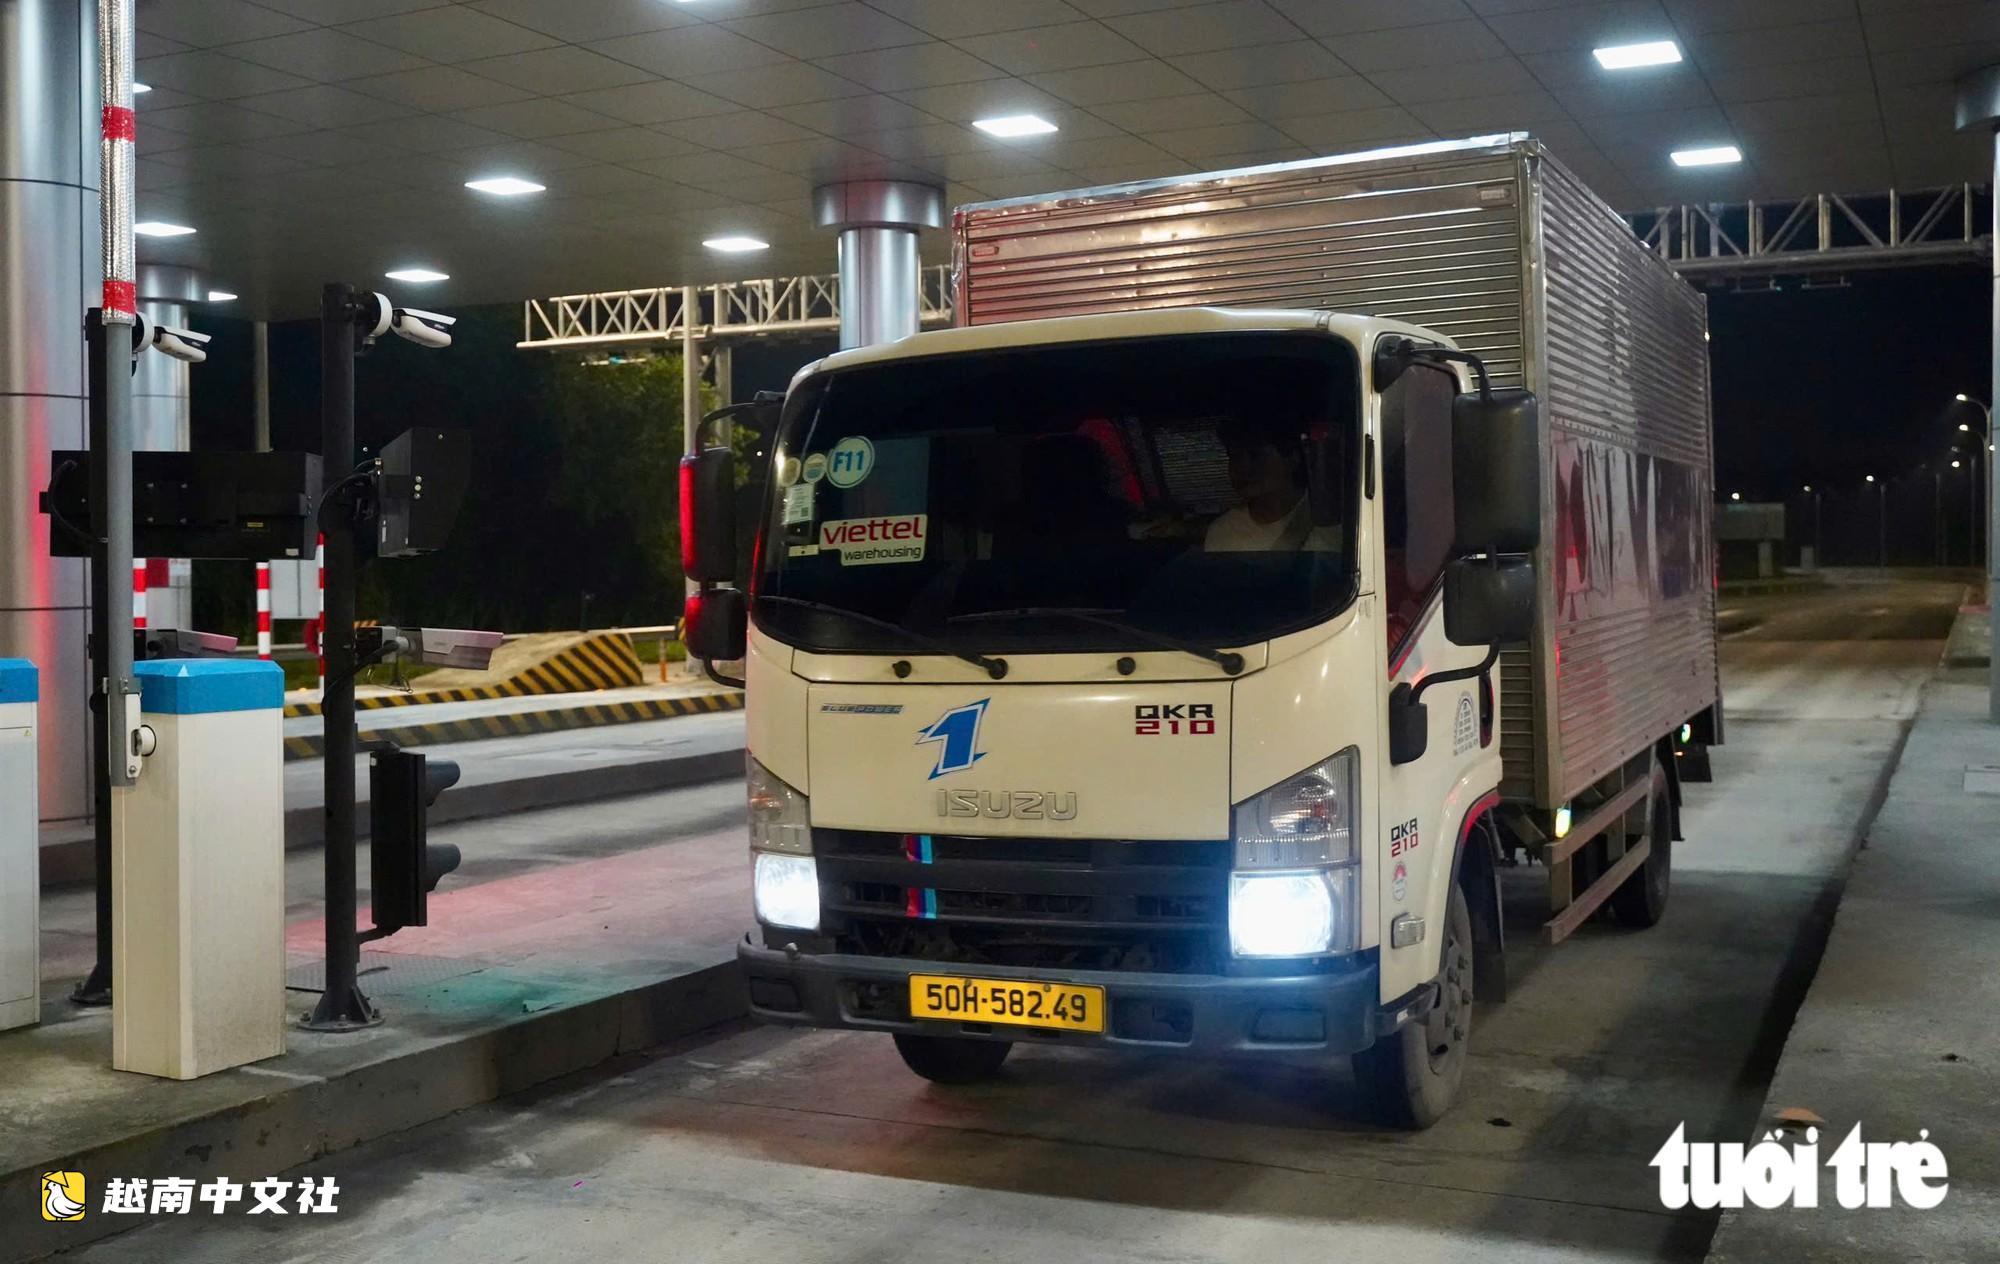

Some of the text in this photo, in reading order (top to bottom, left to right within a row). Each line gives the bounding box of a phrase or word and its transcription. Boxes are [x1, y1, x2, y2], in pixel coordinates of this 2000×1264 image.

[832, 450, 865, 472] F11
[823, 517, 923, 545] viettel
[844, 546, 922, 561] warehousing
[1135, 704, 1214, 719] QKR
[1135, 720, 1215, 735] 210
[936, 789, 1078, 820] ISUZU
[1391, 817, 1418, 842] QKR
[1391, 832, 1418, 857] 210
[926, 984, 1087, 1023] 50H-582.49
